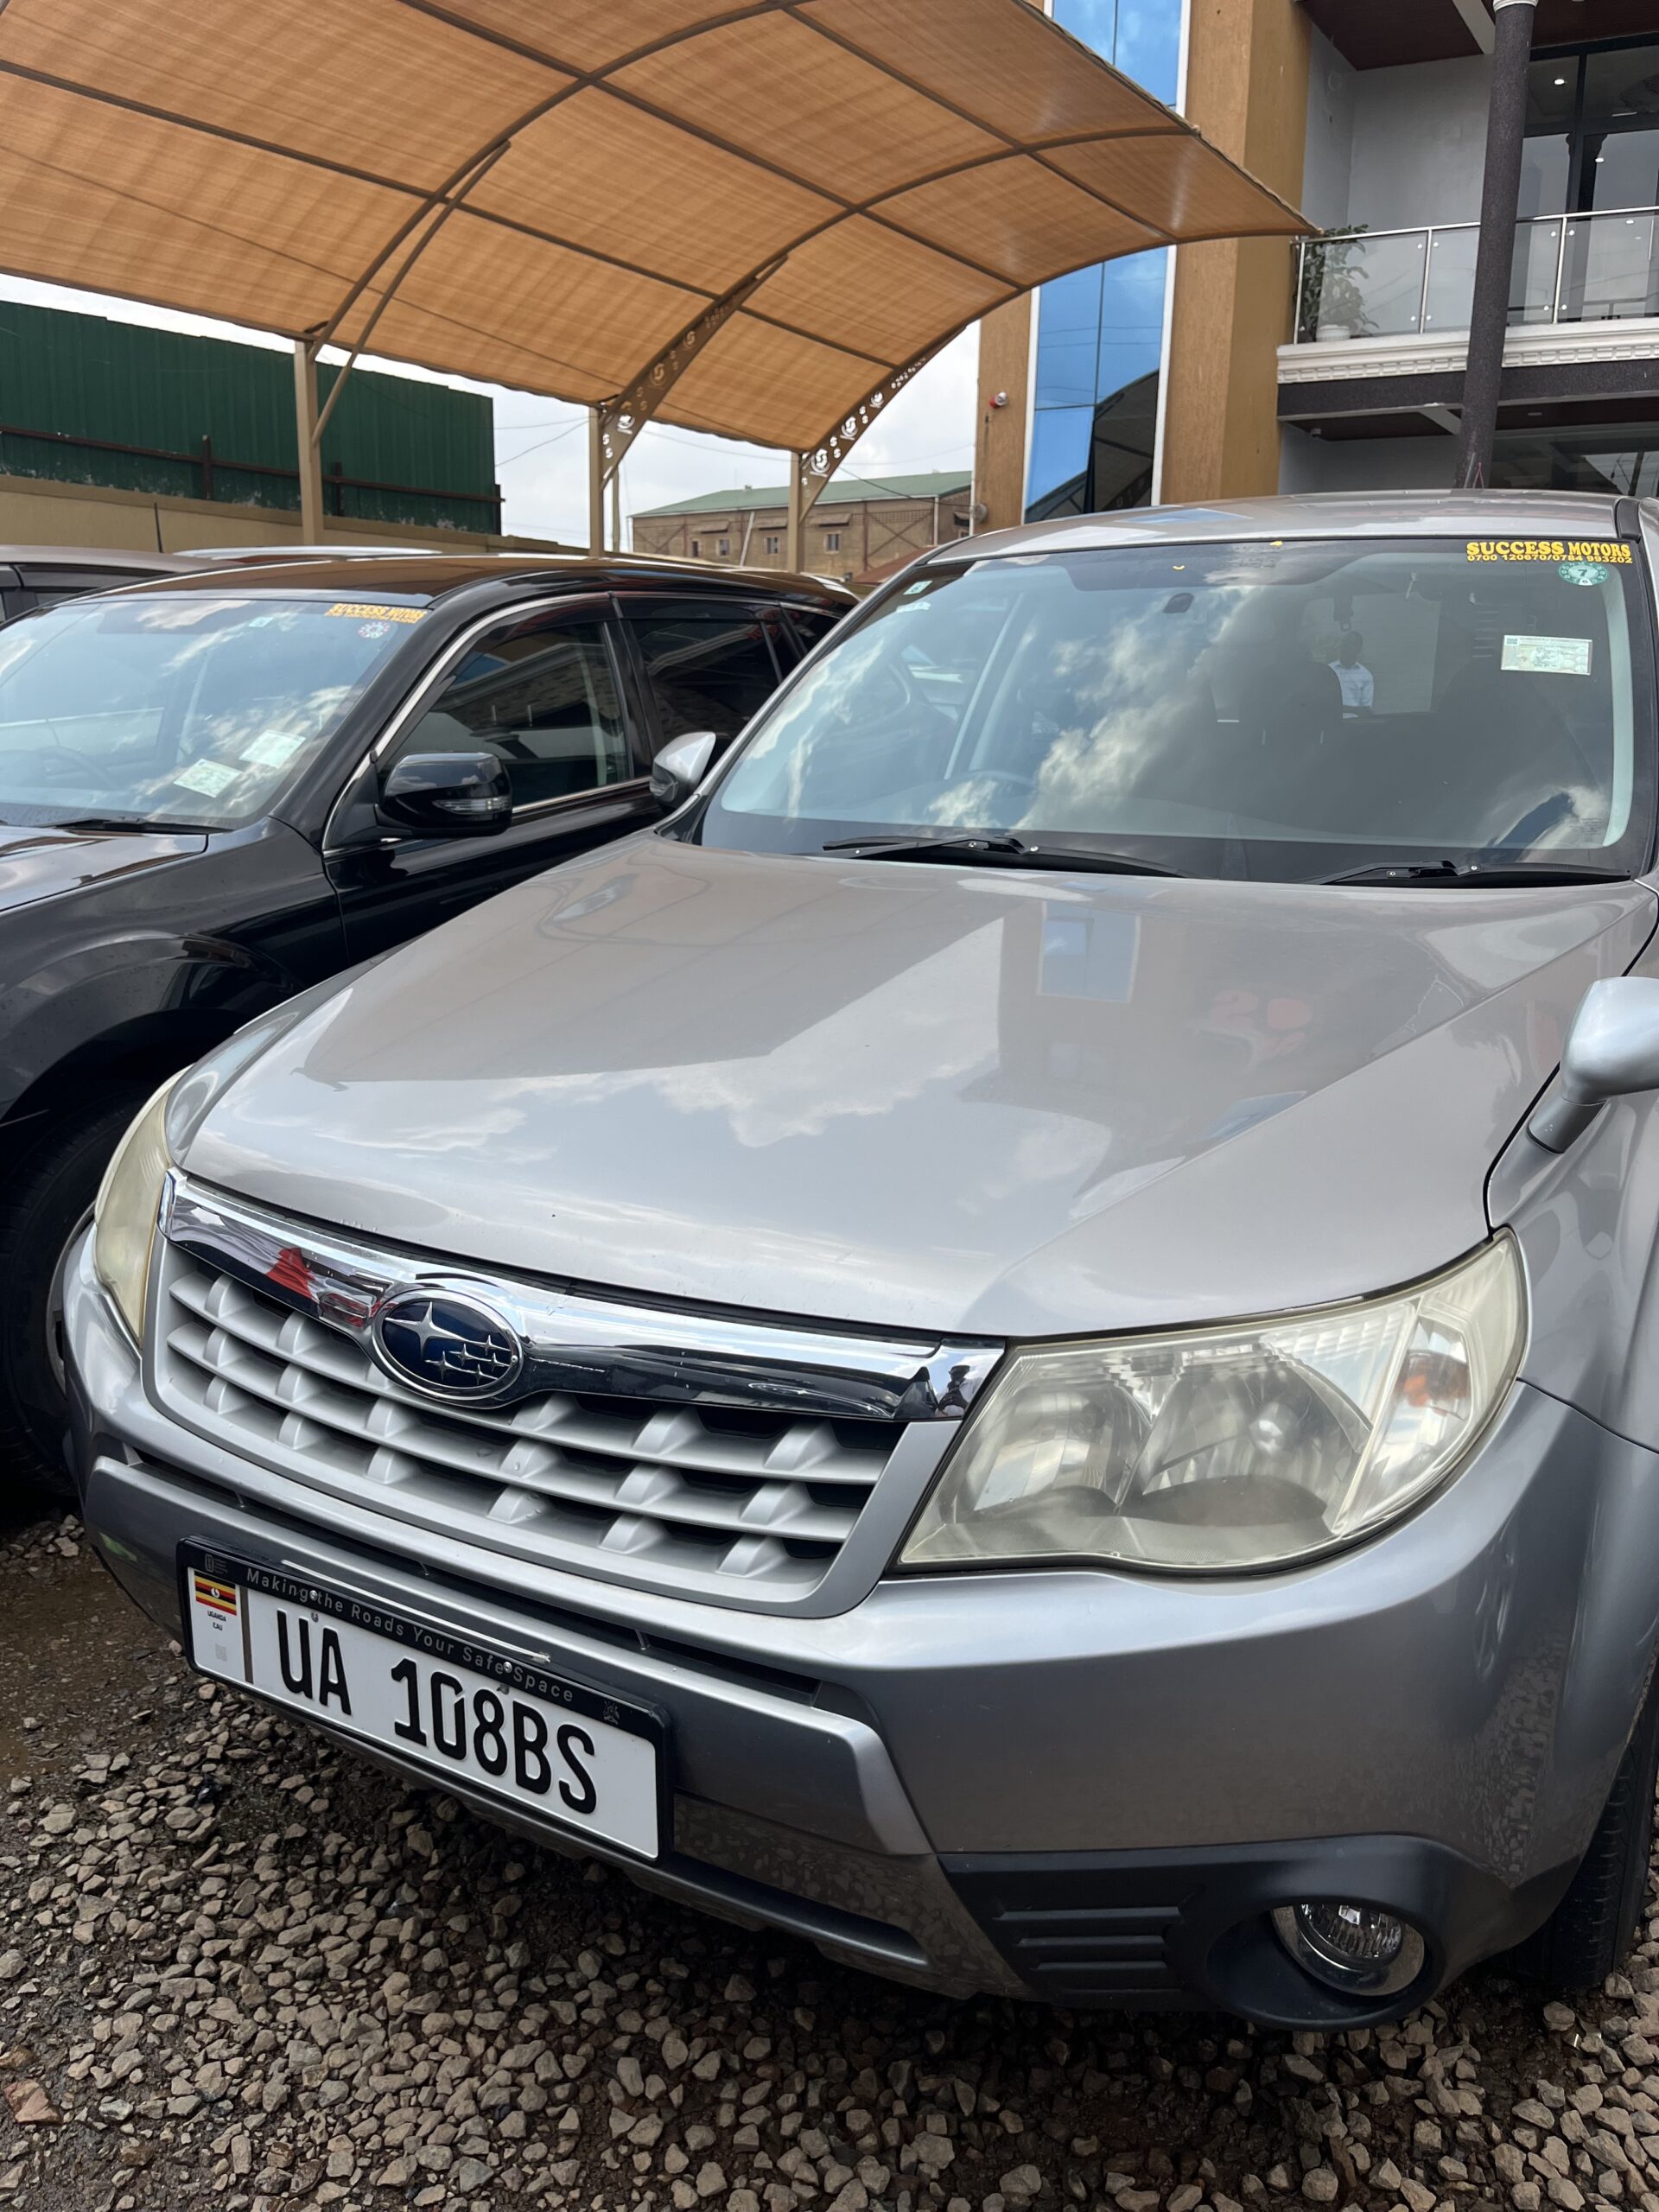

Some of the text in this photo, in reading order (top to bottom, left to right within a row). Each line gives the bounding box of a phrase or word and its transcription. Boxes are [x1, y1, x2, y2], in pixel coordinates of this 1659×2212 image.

[1466, 541, 1630, 557] SUCCESS MOTORS
[1578, 569, 1588, 577] 7
[207, 1610, 226, 1622] UGANDA
[246, 1568, 574, 1702] Making the Roads Your Safe Space
[276, 1611, 596, 1814] UA 108BS
